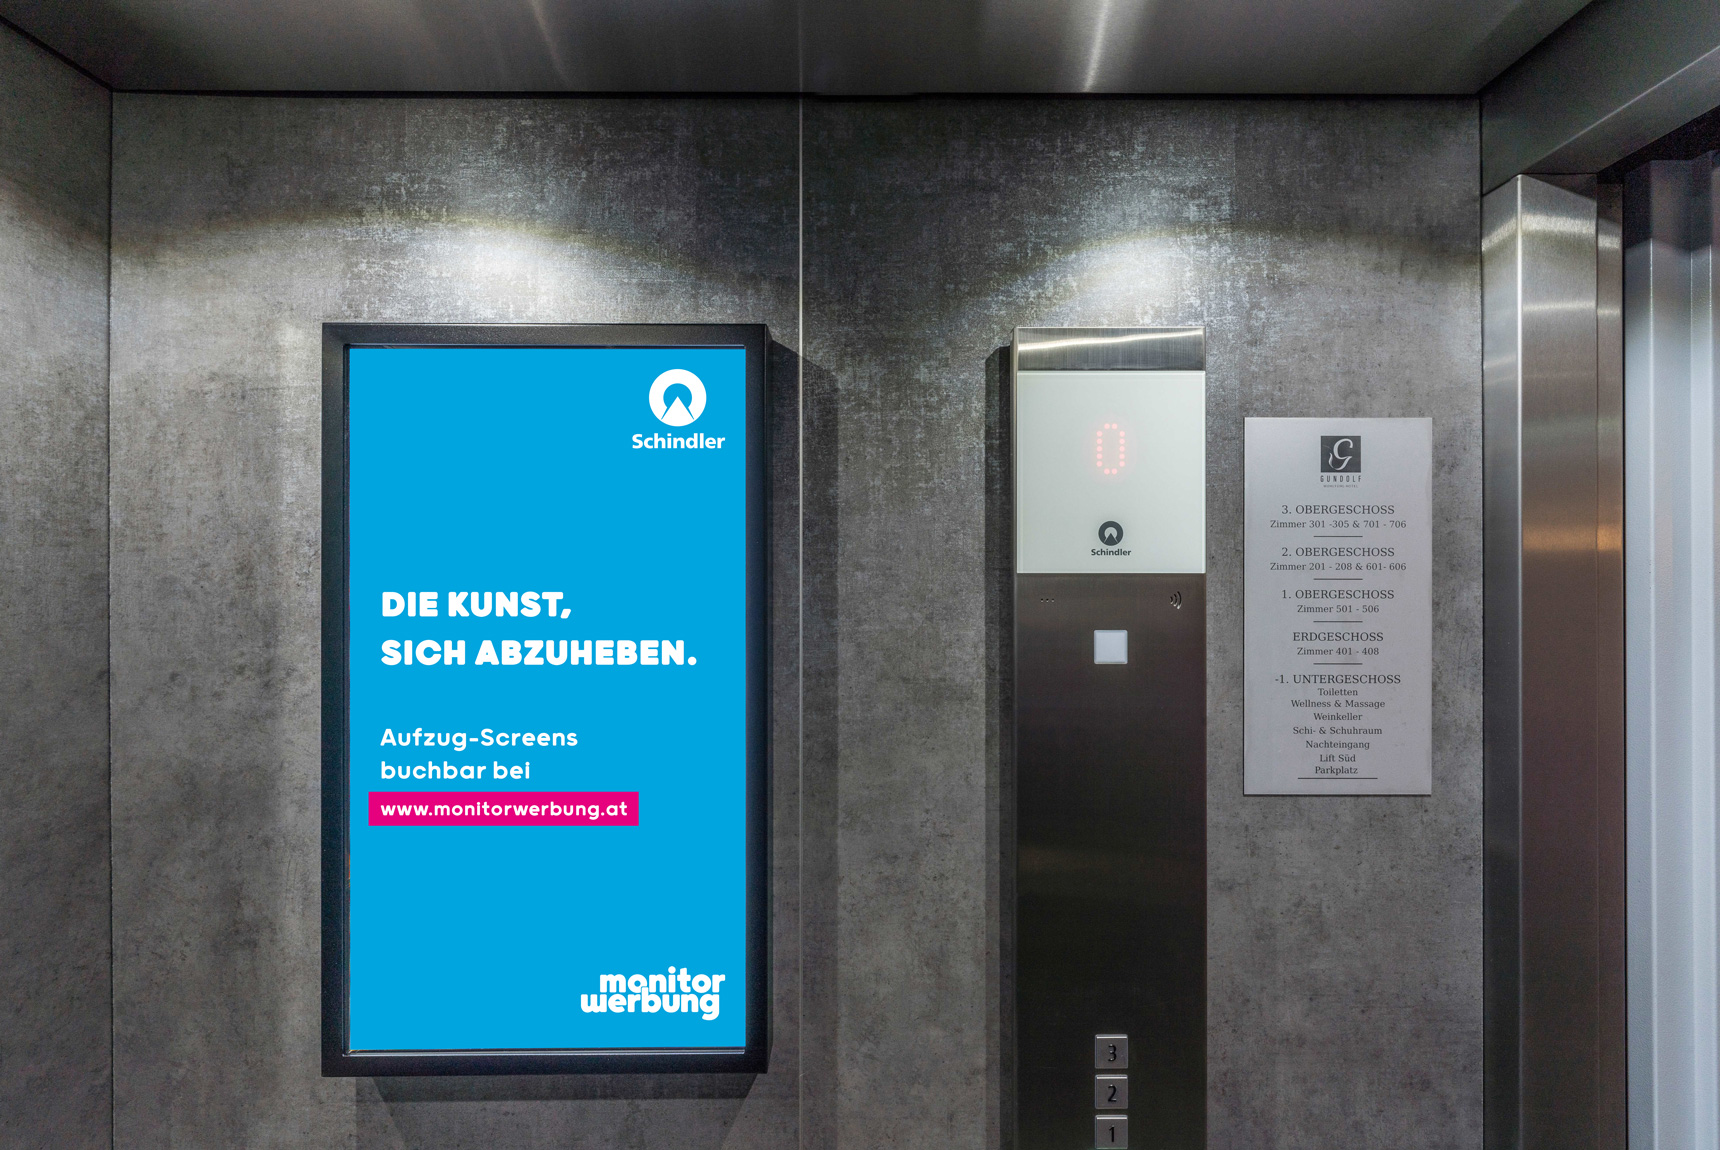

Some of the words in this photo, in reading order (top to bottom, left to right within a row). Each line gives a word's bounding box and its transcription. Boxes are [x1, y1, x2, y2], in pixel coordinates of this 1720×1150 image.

[631, 432, 726, 449] Schindler
[1096, 422, 1126, 476] 0
[1319, 474, 1362, 483] GUNDOLF
[1281, 504, 1292, 515] 3.
[1295, 504, 1395, 515] OBERGESCHOSS
[1269, 519, 1307, 529] Zimmer
[1308, 519, 1325, 529] 301
[1352, 519, 1360, 529] &
[1363, 519, 1380, 529] 701
[1389, 519, 1407, 529] 706
[1090, 548, 1132, 556] Schindler
[1281, 546, 1292, 557] 2.
[1295, 546, 1395, 557] OBERGESCHOSS
[1269, 562, 1307, 571] Zimmer
[1309, 562, 1326, 571] 201
[1335, 562, 1353, 571] 208
[1354, 562, 1364, 571] &
[1388, 562, 1407, 571] 606
[1282, 589, 1292, 599] 1.
[1295, 589, 1395, 600] OBERGESCHOSS
[382, 591, 439, 617] DIE
[448, 591, 572, 619] KUNST,
[1296, 604, 1334, 613] Zimmer
[1336, 604, 1353, 613] 501
[1362, 604, 1380, 613] 506
[1292, 631, 1384, 642] ERDGESCHOSS
[380, 639, 466, 666] SICH
[474, 639, 697, 666] ABZUHEBEN.
[1296, 647, 1334, 656] Zimmer
[1335, 647, 1353, 656] 401
[1361, 647, 1380, 656] 408
[1274, 674, 1289, 684] -1.
[1292, 674, 1402, 684] UNTERGESCHOSS
[1317, 687, 1359, 696] Toiletten
[1290, 699, 1332, 708] Wellness
[1333, 699, 1342, 708] &
[1344, 699, 1386, 710] Massage
[1313, 712, 1364, 721] Weinkeller
[1292, 726, 1316, 735] Schi-
[1318, 726, 1327, 735] &
[1329, 726, 1383, 735] Schuhraum
[380, 727, 578, 751] Aufzug-Screens
[1305, 739, 1370, 750] Nachteingang
[1319, 753, 1336, 763] Lift
[1338, 753, 1356, 763] Süd
[381, 759, 487, 780] buchbar
[493, 759, 531, 780] bei
[1314, 765, 1359, 775] Parkplatz
[380, 800, 628, 821] www.monitorwerbung.at
[599, 965, 726, 994] monitor
[580, 986, 720, 1021] werbung
[1107, 1043, 1118, 1063] 3
[1107, 1083, 1118, 1103] 2
[1108, 1125, 1115, 1143] 1
